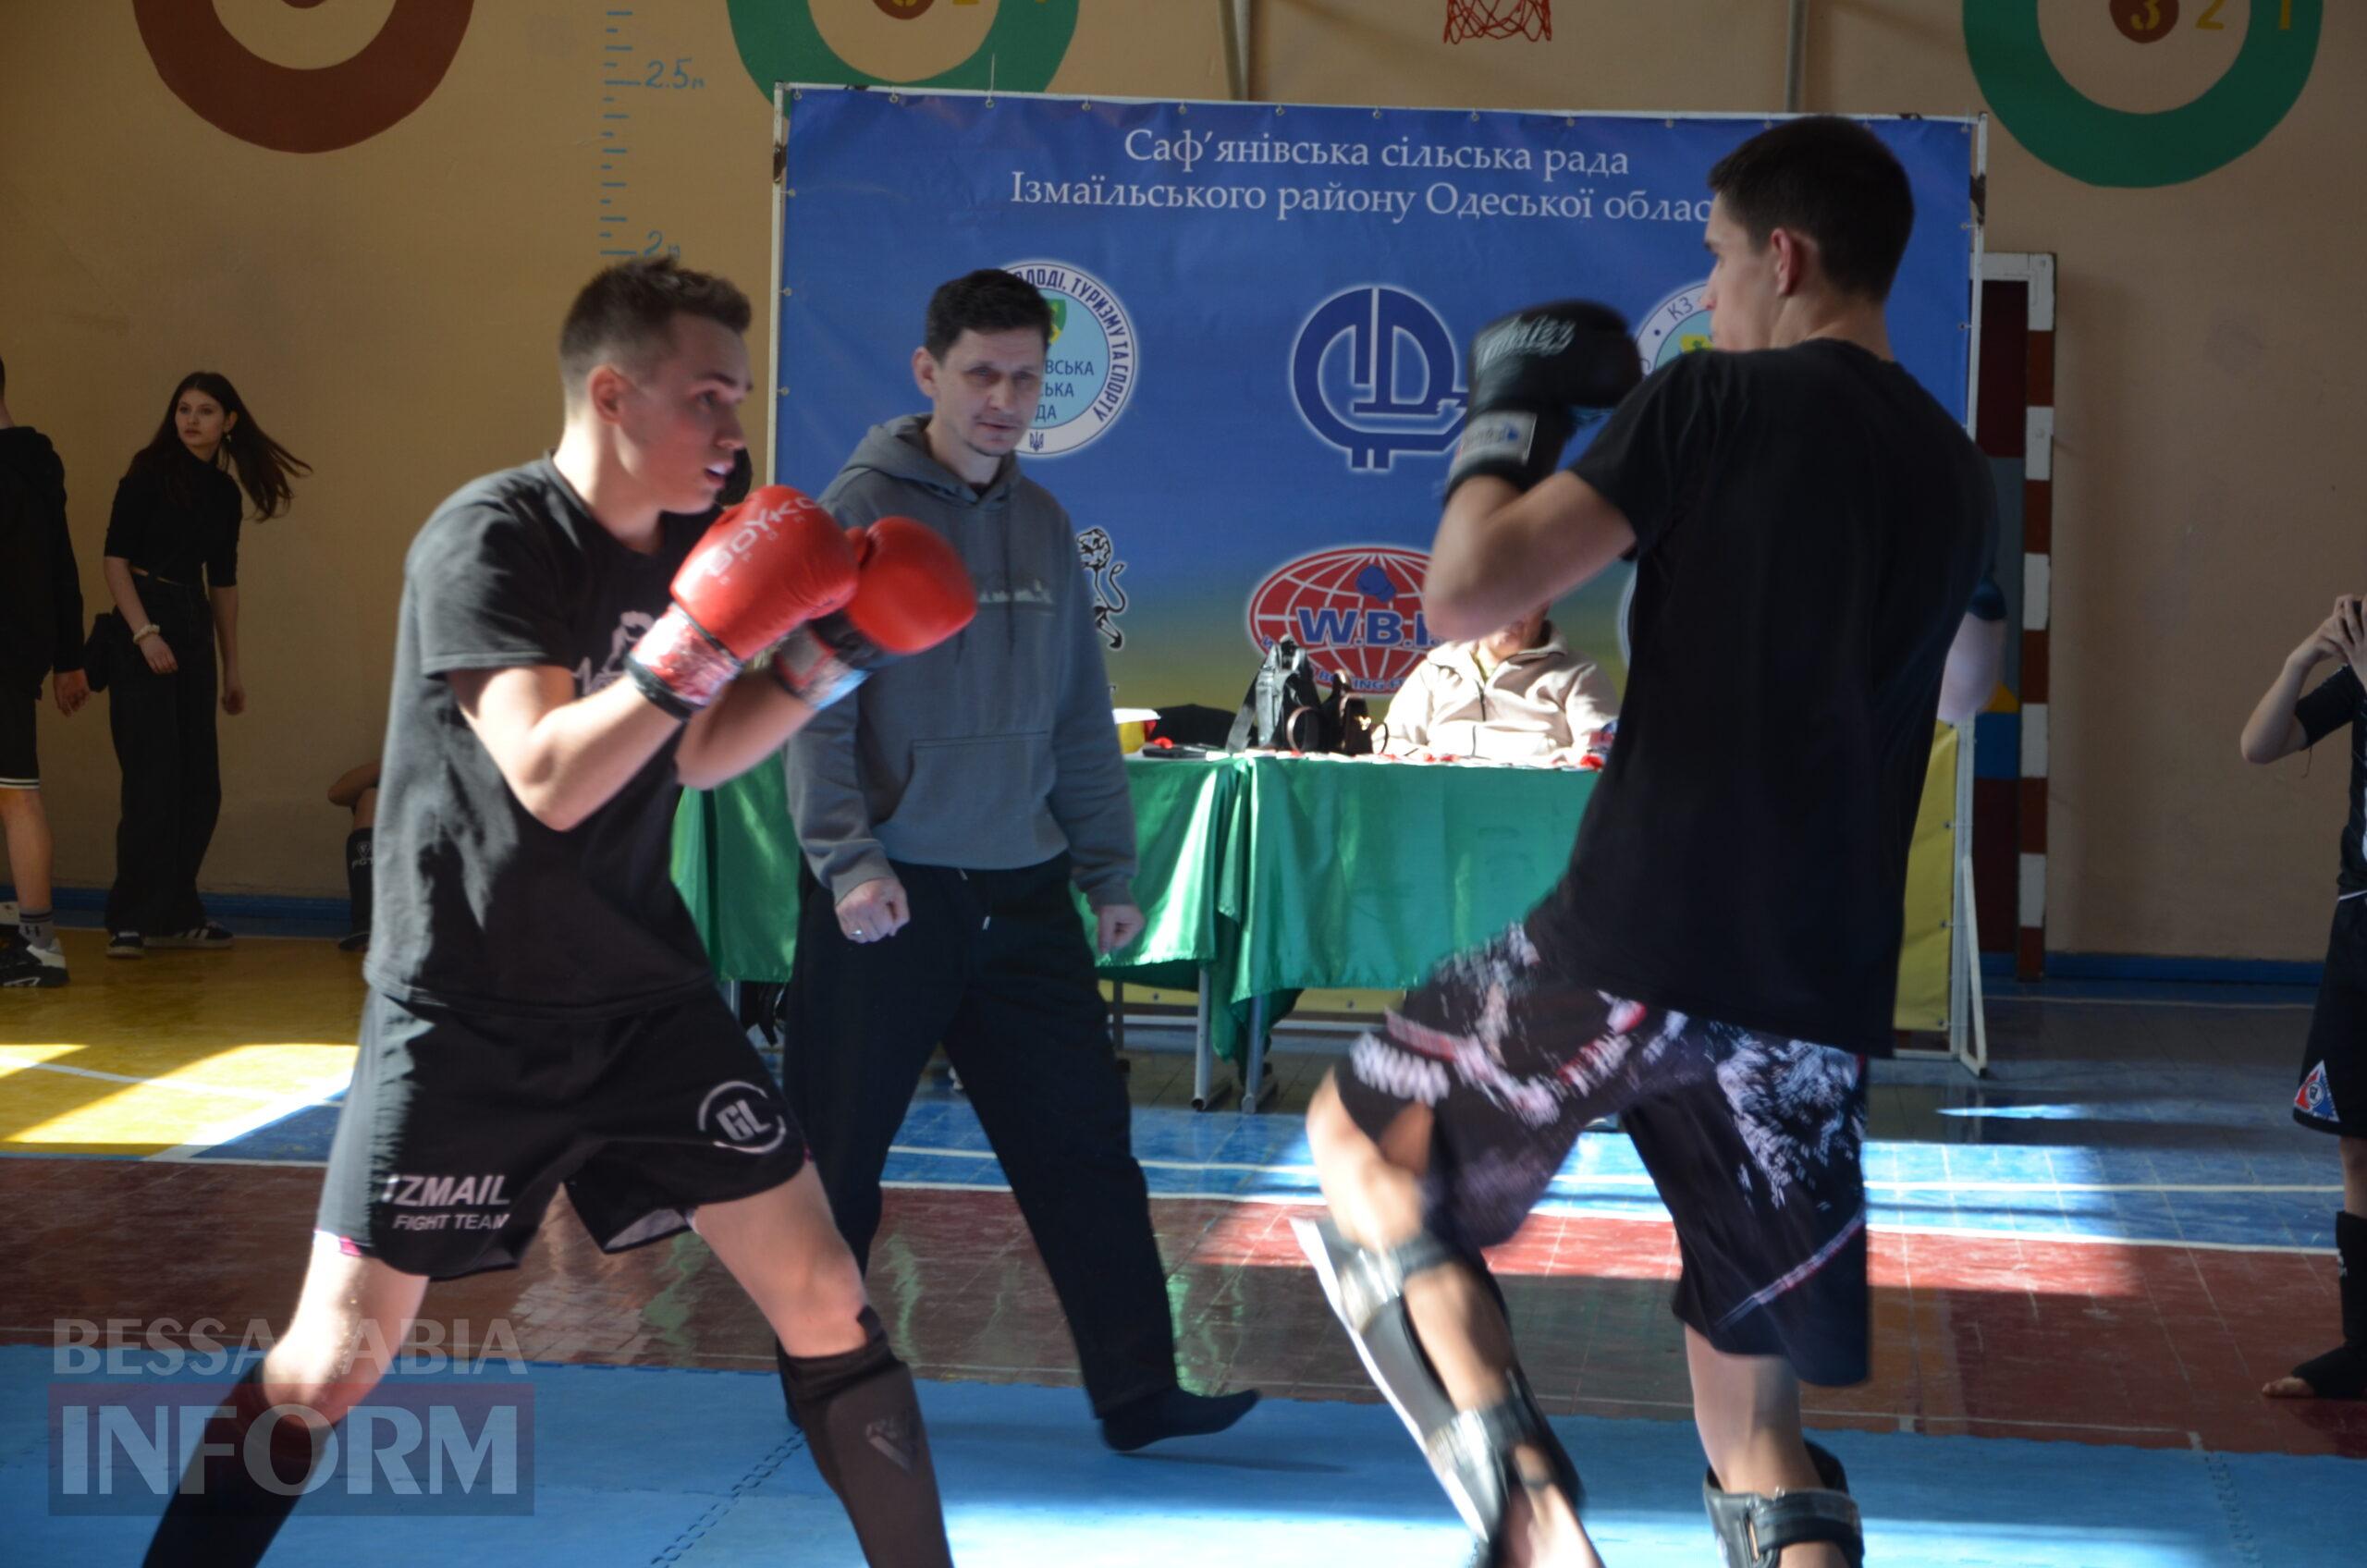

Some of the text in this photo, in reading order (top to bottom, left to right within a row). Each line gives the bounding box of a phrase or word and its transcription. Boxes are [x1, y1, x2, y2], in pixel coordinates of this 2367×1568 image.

[1381, 137, 1532, 170] сільська
[1543, 149, 1629, 182] рада
[1011, 171, 1712, 224] Ізмаїльського району Одеської облас
[1071, 277, 1126, 337] ТУРИЗМУ
[1045, 359, 1095, 376] ВСЬКА
[1111, 342, 1129, 361] ТА
[1093, 364, 1128, 423] СПОРТУ
[1036, 404, 1057, 423] ДА
[381, 1174, 510, 1207] IZMAIL
[391, 1213, 451, 1231] FIGHT
